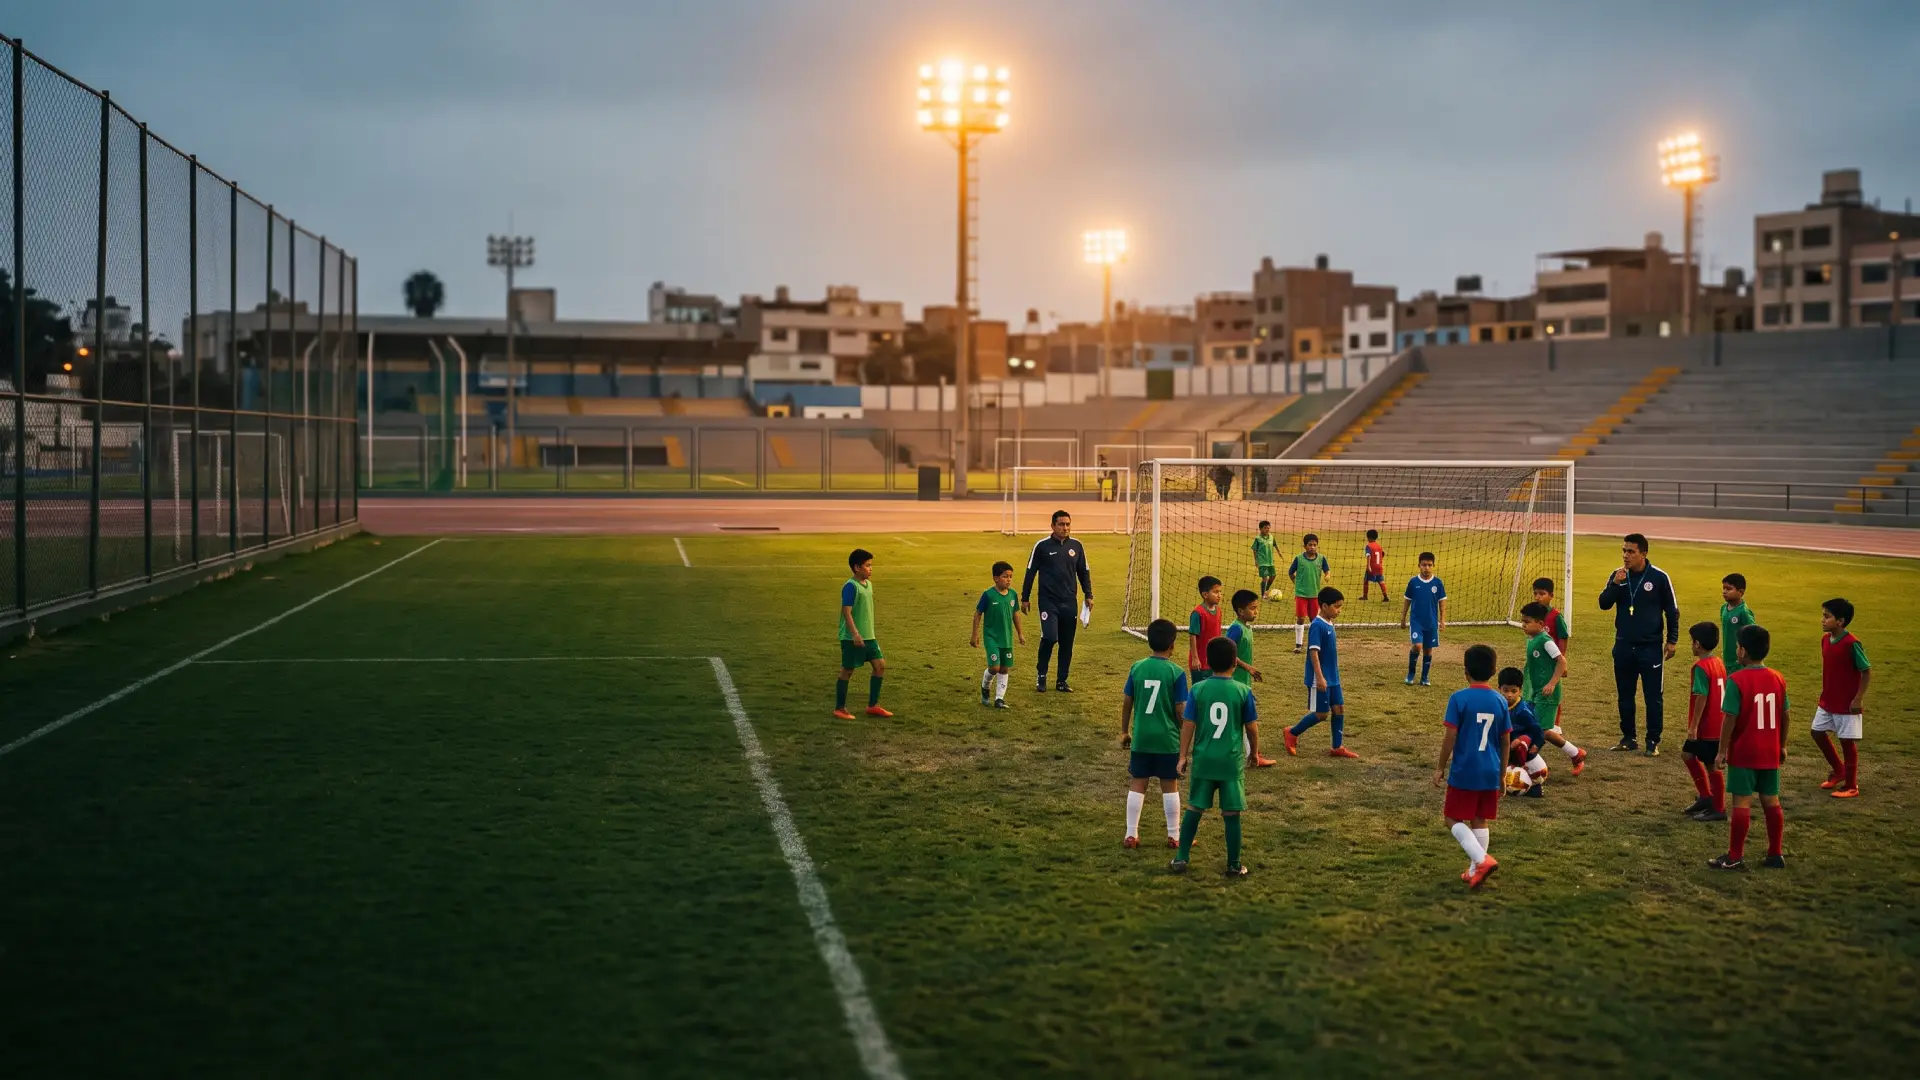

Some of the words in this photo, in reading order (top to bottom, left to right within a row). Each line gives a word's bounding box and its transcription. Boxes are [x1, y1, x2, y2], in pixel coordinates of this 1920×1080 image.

[1144, 680, 1161, 715] 7
[1754, 692, 1776, 730] 11
[1209, 701, 1229, 739] 9
[1476, 712, 1495, 752] 7
